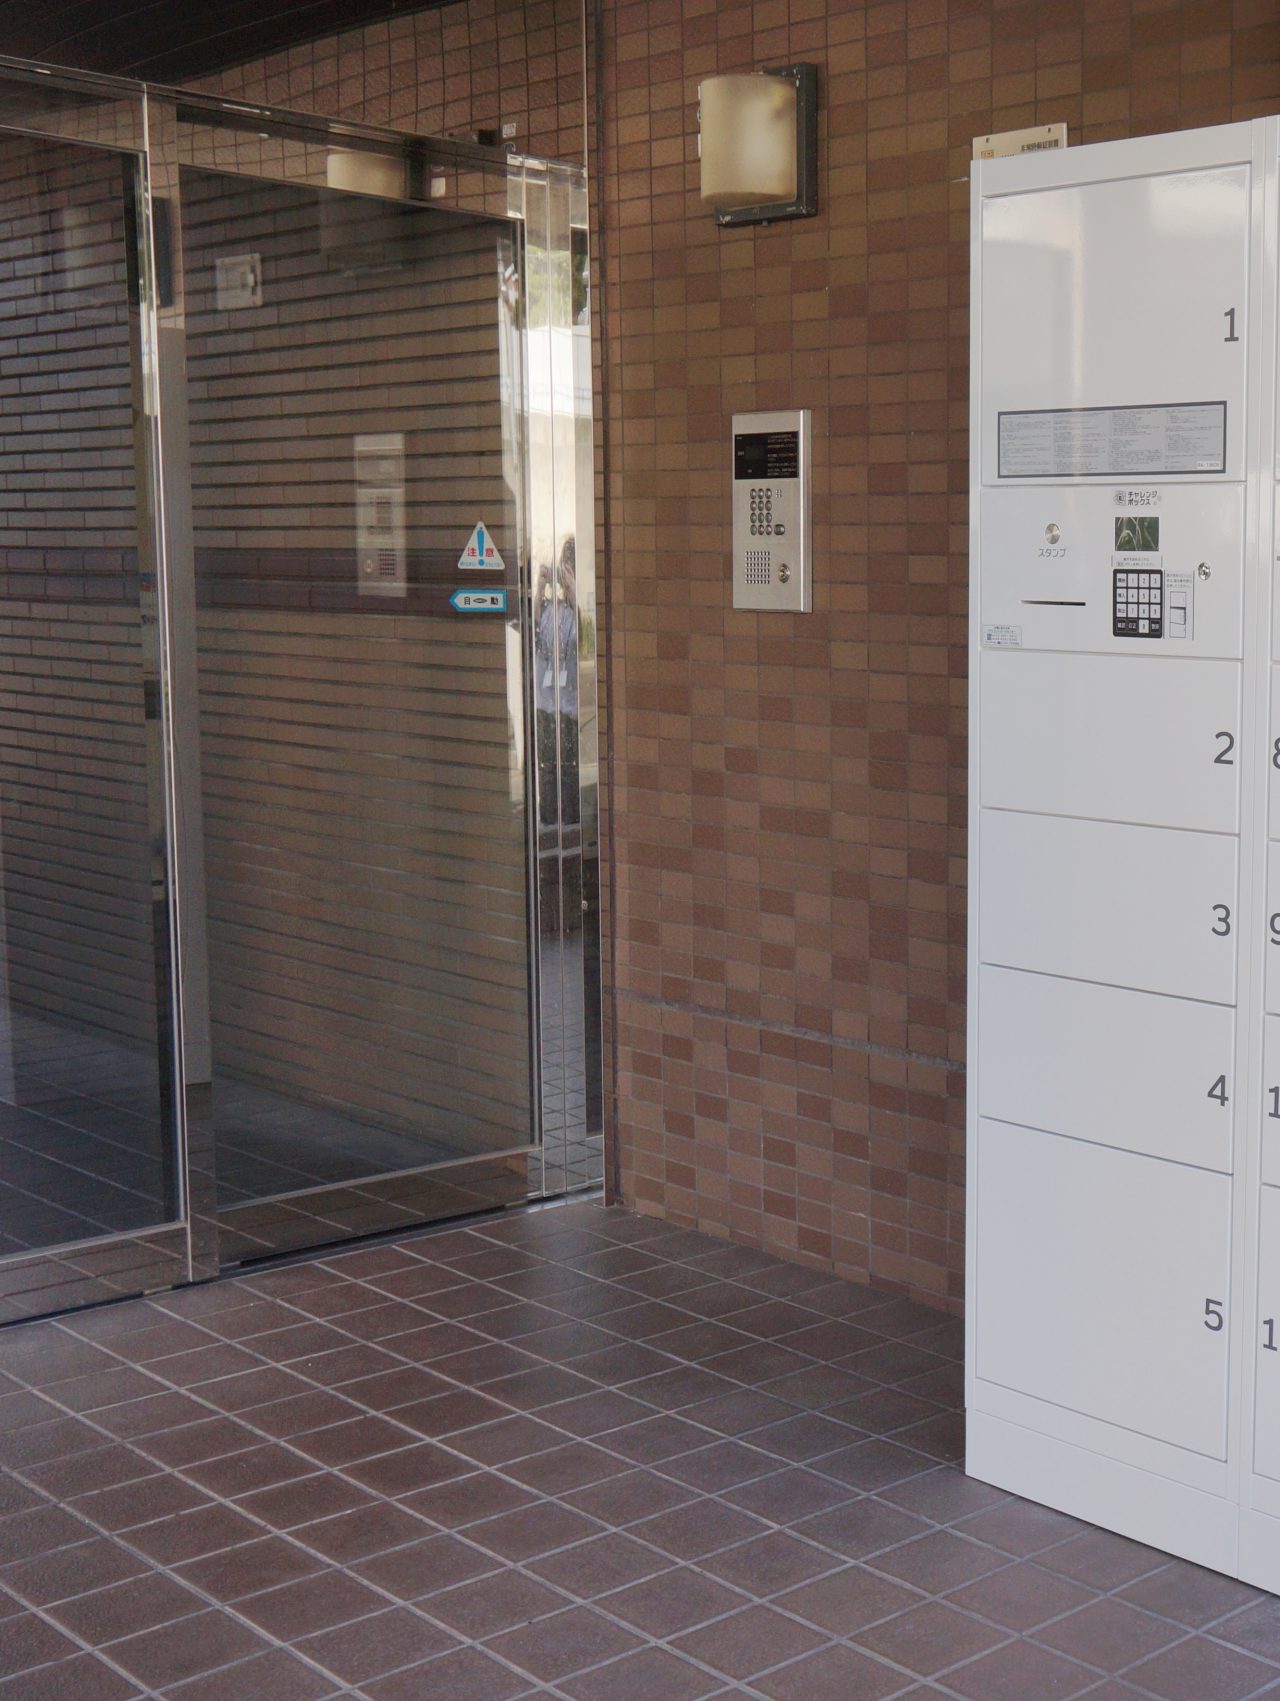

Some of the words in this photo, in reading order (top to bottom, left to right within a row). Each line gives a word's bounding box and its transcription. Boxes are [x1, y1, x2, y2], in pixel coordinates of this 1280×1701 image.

[1224, 307, 1240, 342] 1
[1127, 490, 1158, 498] チャレンジ
[1127, 498, 1152, 506] ボックス
[1038, 548, 1066, 558] スタンプ
[1214, 731, 1235, 765] 2
[1211, 903, 1231, 937] 3
[1207, 1074, 1229, 1107] 4
[1203, 1298, 1224, 1332] 5
